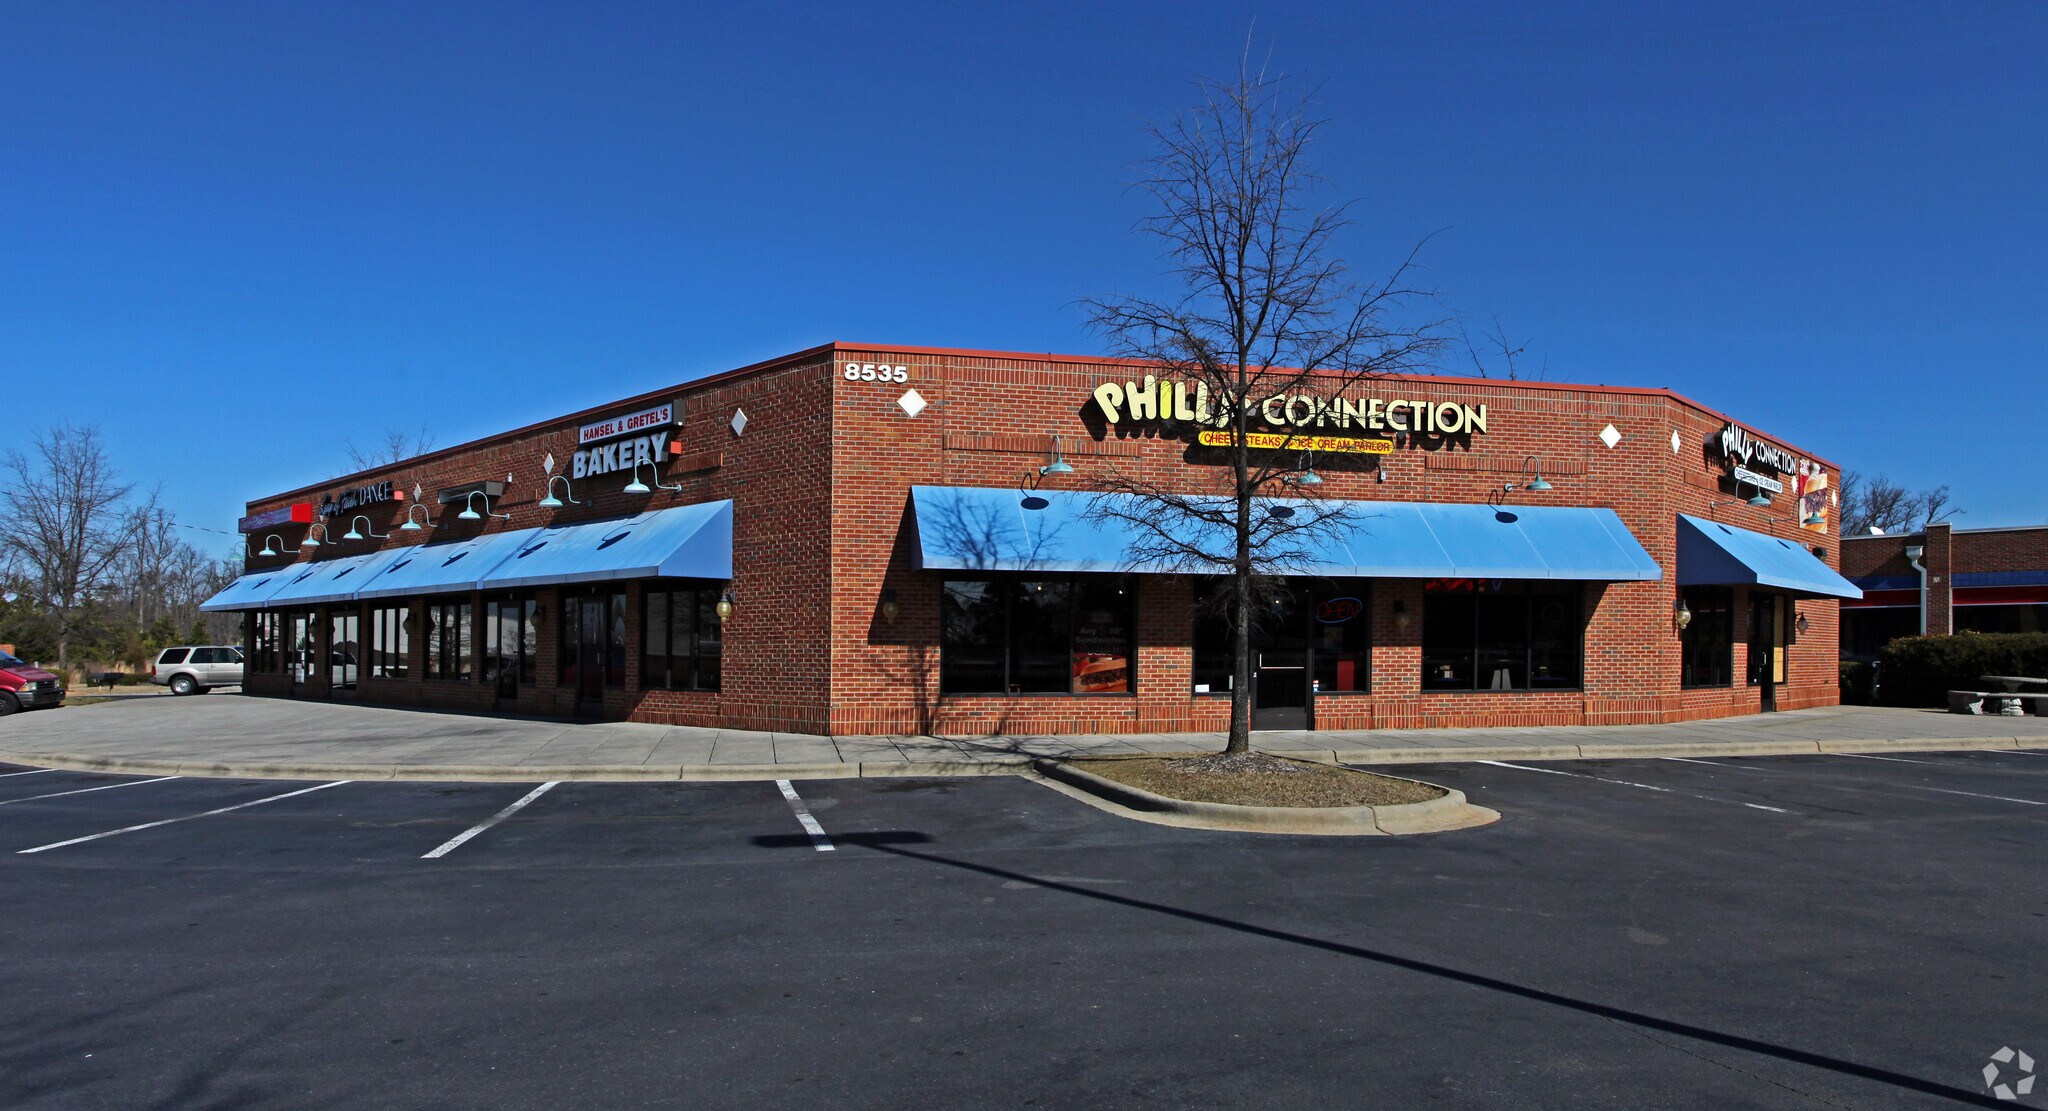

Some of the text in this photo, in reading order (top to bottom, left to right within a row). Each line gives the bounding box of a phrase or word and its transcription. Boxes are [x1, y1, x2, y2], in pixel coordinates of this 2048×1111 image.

[844, 363, 908, 384] 8535
[583, 408, 668, 441] HANSEL & GRETEL'S
[1262, 393, 1487, 435] CONNECTION
[573, 431, 668, 480] BAKERY
[1204, 433, 1281, 447] CHEESTEAKS
[1298, 437, 1313, 448] ICE
[1318, 439, 1350, 450] CREAM
[1353, 441, 1390, 452] PARLOR
[1722, 422, 1797, 475] PHILLY CONNECTION
[360, 480, 389, 506] DANCE
[1316, 600, 1361, 619] OPEN
